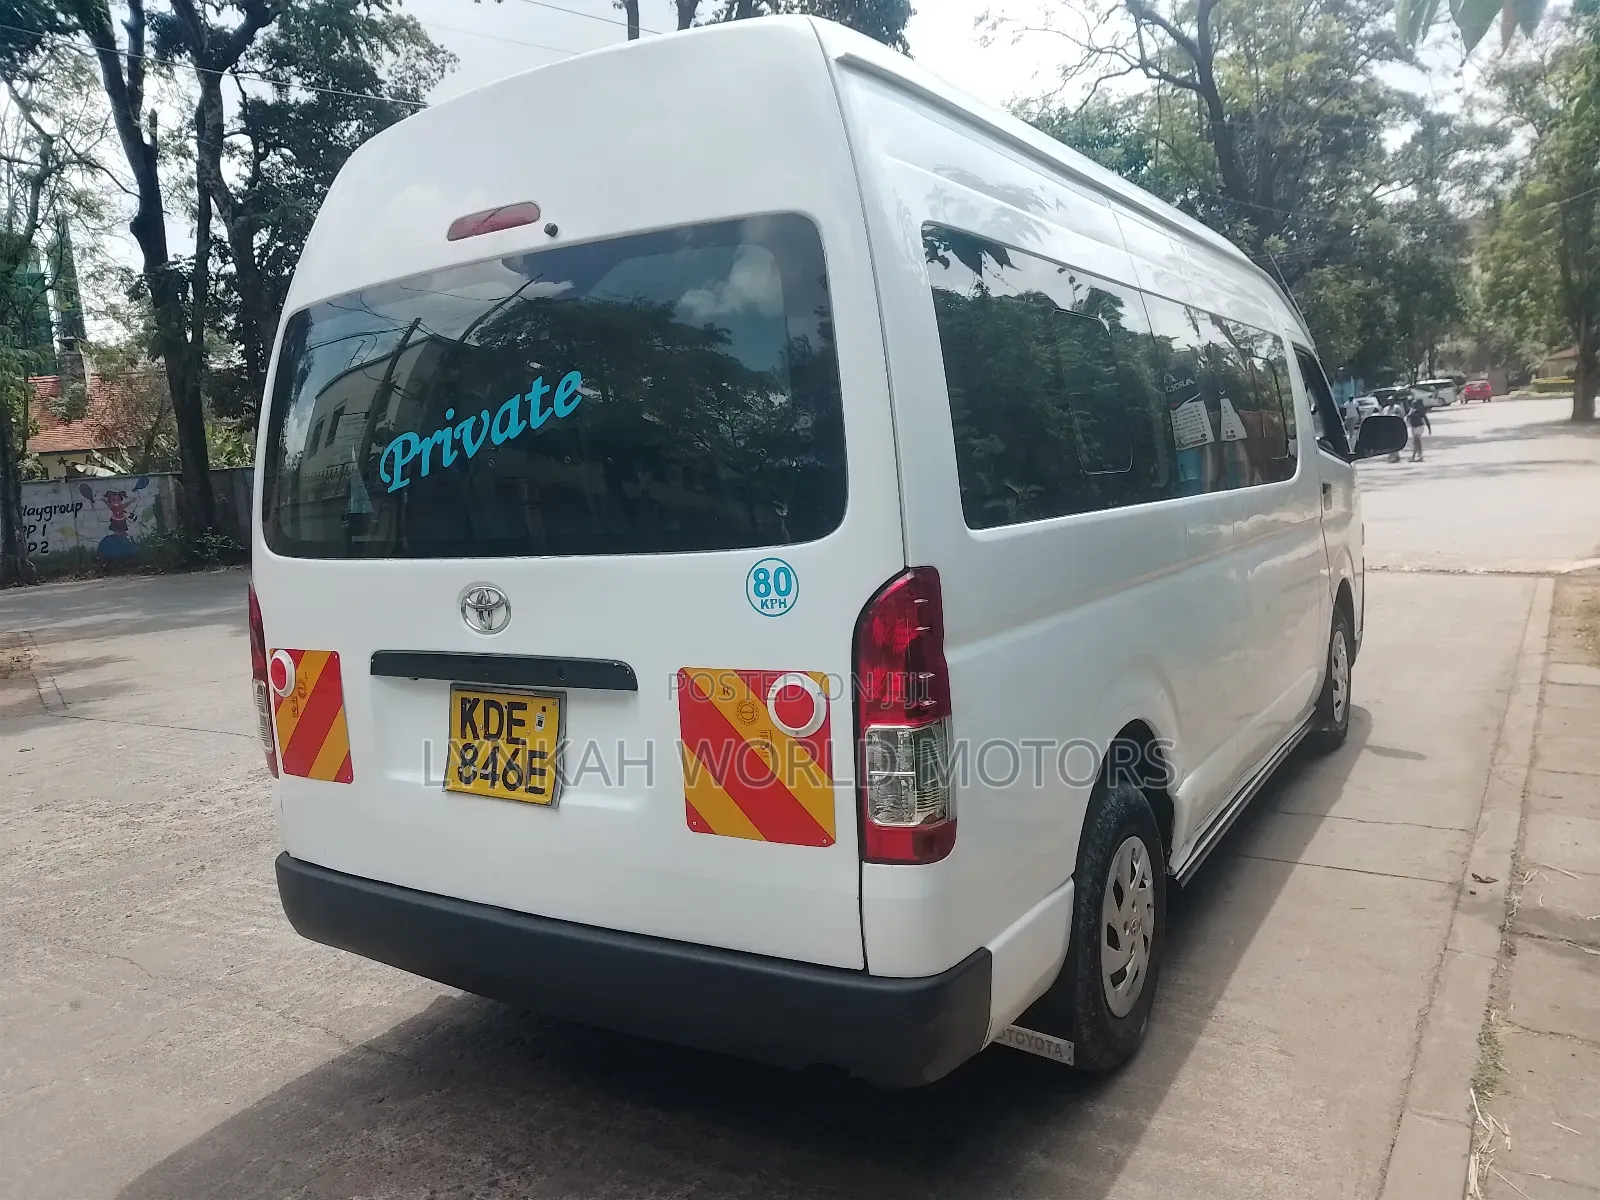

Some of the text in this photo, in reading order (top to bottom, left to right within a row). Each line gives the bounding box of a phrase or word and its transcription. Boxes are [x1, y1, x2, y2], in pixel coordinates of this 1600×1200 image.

[380, 370, 583, 493] Private
[22, 502, 83, 522] laygroup
[40, 540, 49, 554] 2
[753, 566, 792, 598] 80
[760, 598, 788, 609] KPH
[460, 696, 528, 746] KDE
[457, 742, 549, 795] 846E
[1006, 1028, 1063, 1058] TOYOTA
